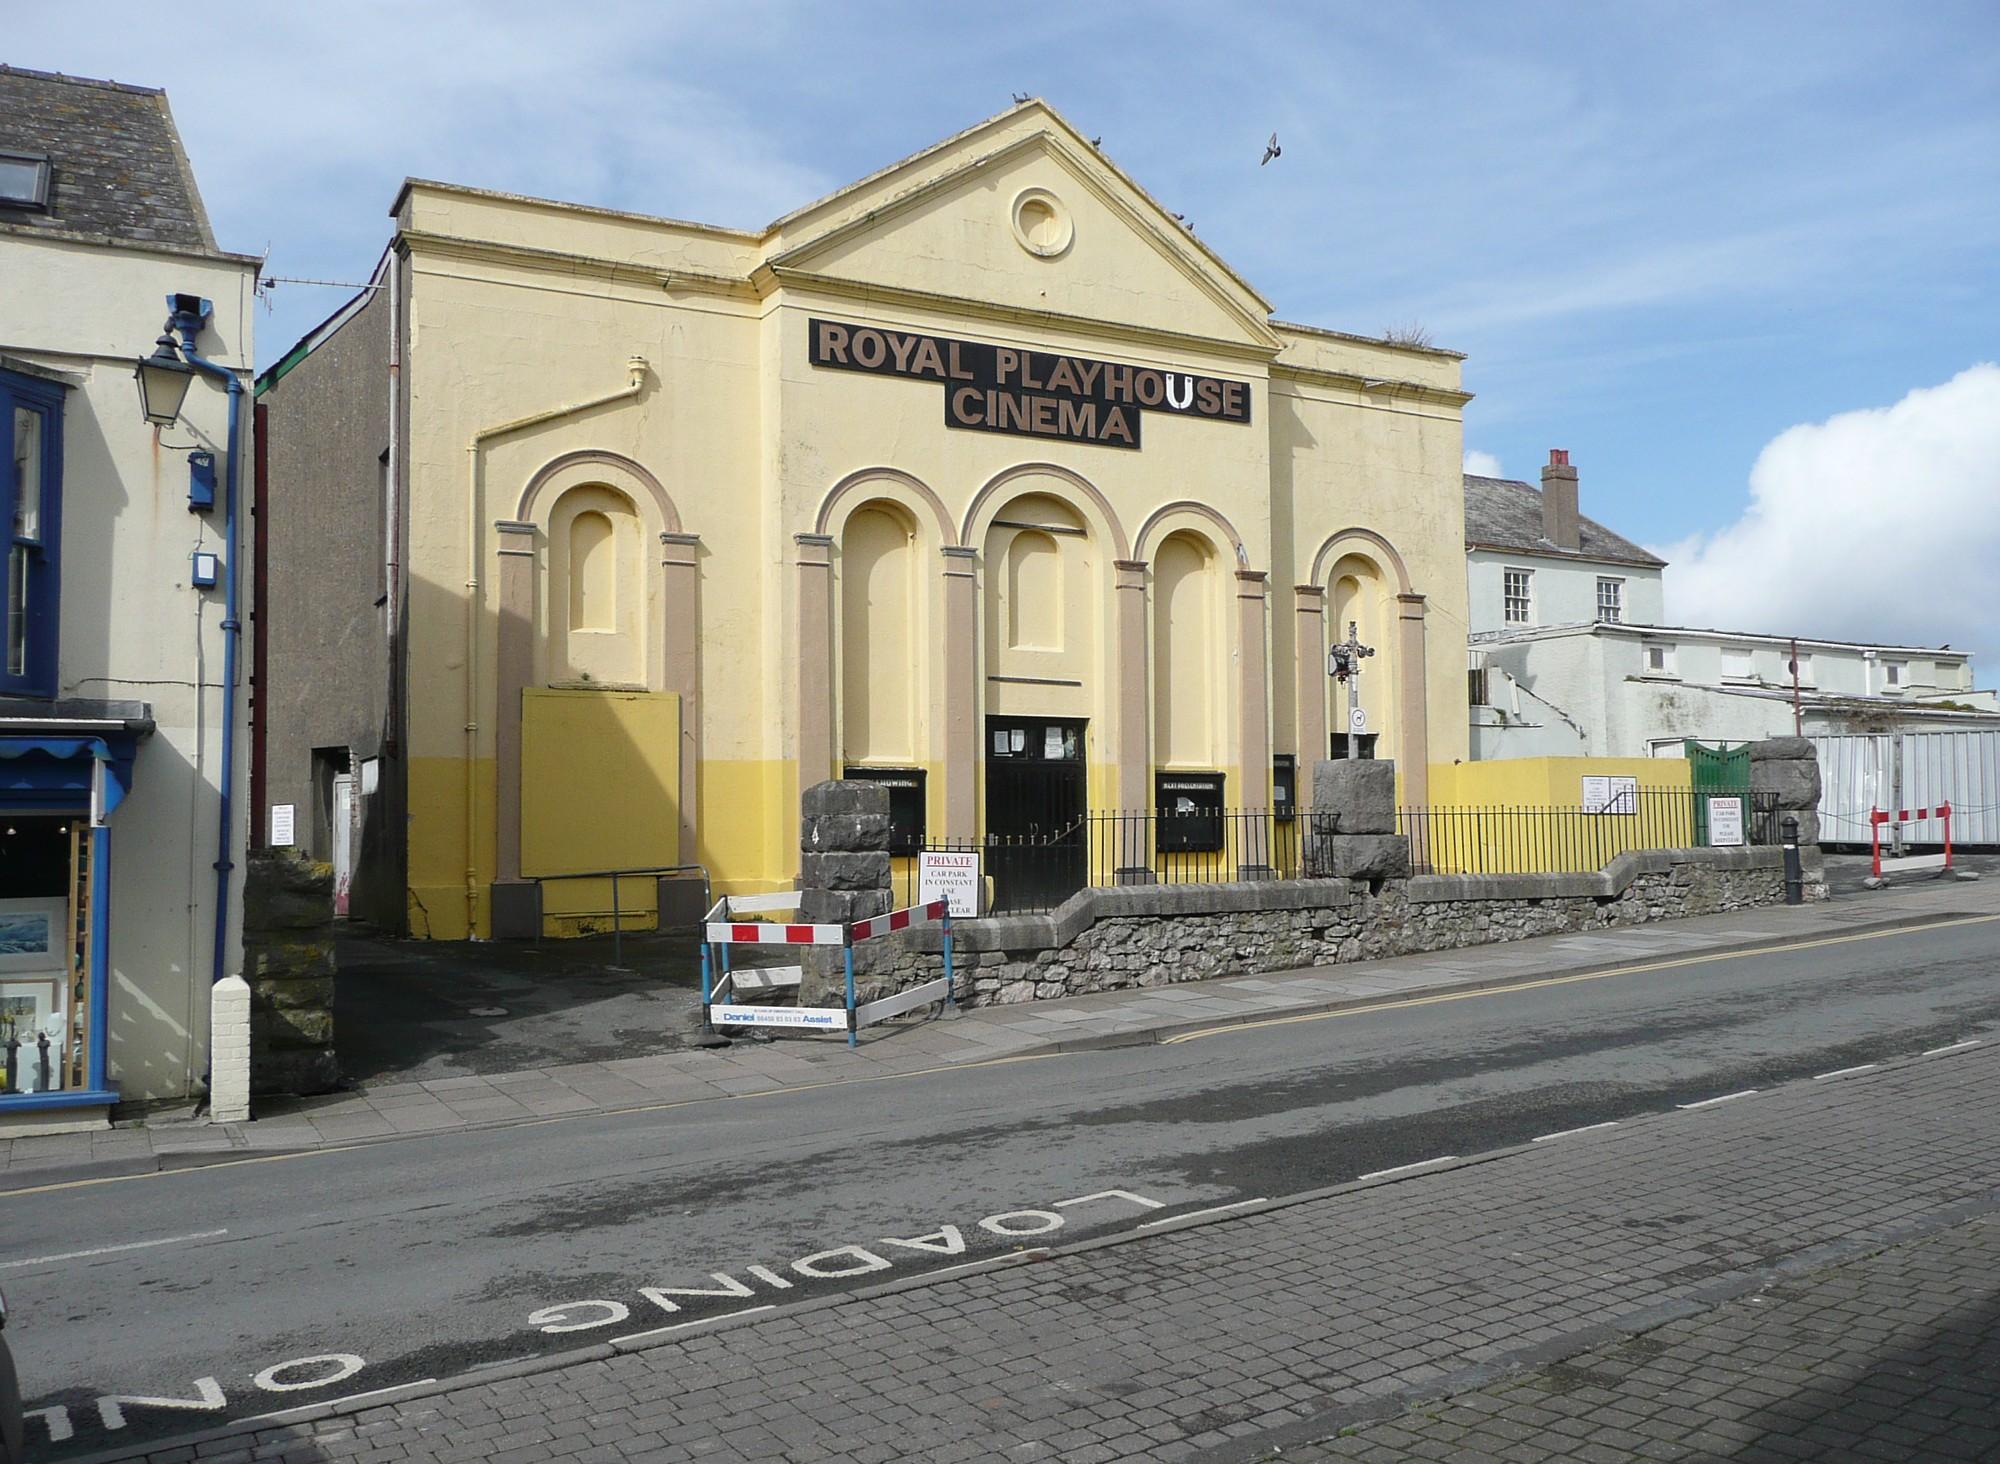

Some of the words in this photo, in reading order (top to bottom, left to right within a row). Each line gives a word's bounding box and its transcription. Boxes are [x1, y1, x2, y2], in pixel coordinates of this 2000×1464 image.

[819, 323, 974, 380] ROYAL
[996, 348, 1242, 416] PLAYHOUSE
[952, 386, 1134, 443] CINEMA
[927, 855, 973, 866] PRIVATE
[723, 1012, 755, 1021] Daniel
[802, 1015, 833, 1024] Assist
[527, 1190, 1166, 1333] LOADING
[22, 1354, 366, 1442] ONL
